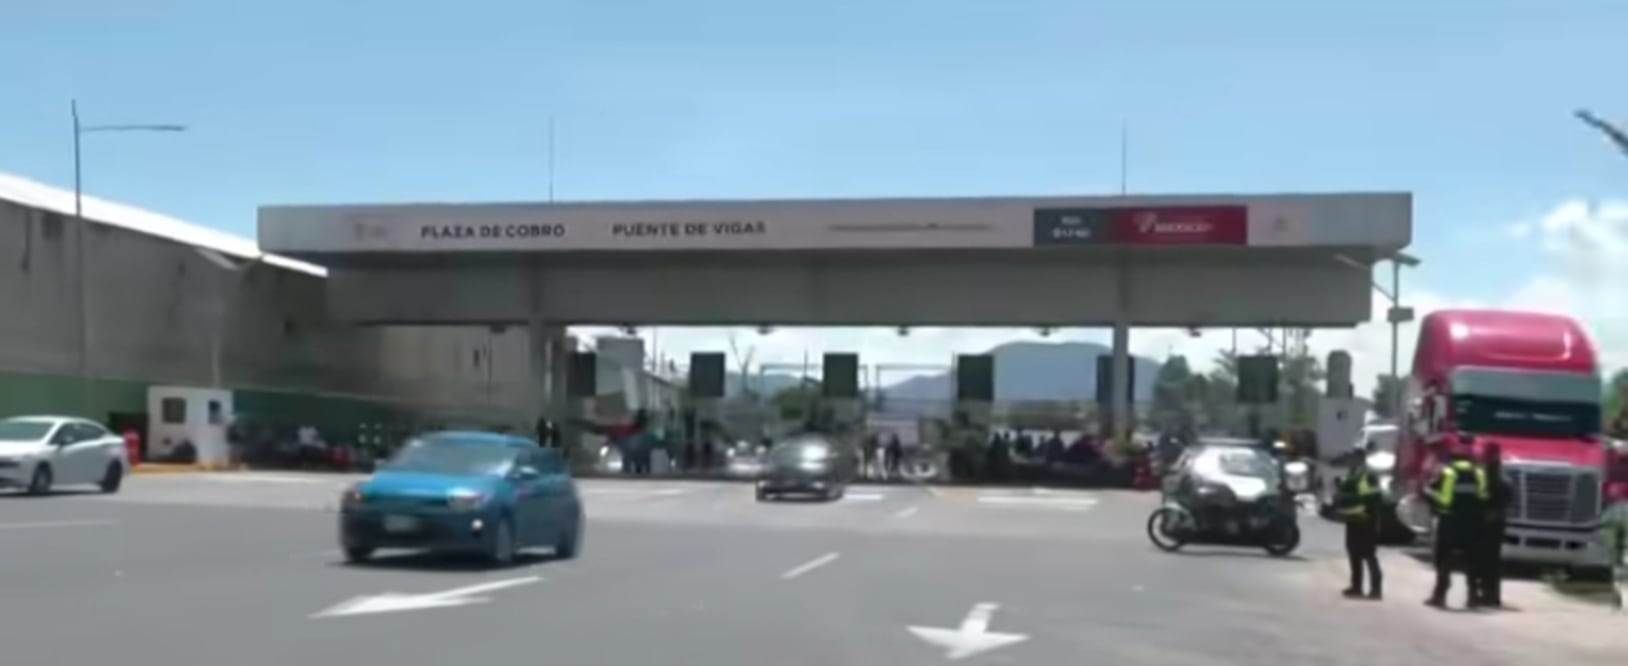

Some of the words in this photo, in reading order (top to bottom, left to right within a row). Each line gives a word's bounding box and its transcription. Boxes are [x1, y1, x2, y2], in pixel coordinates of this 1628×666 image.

[421, 225, 475, 238] PLAZA
[480, 225, 501, 238] DE
[505, 224, 566, 237] COBRO
[613, 223, 679, 236] PUENTE
[685, 223, 706, 235] DE
[713, 221, 766, 234] VIGAS
